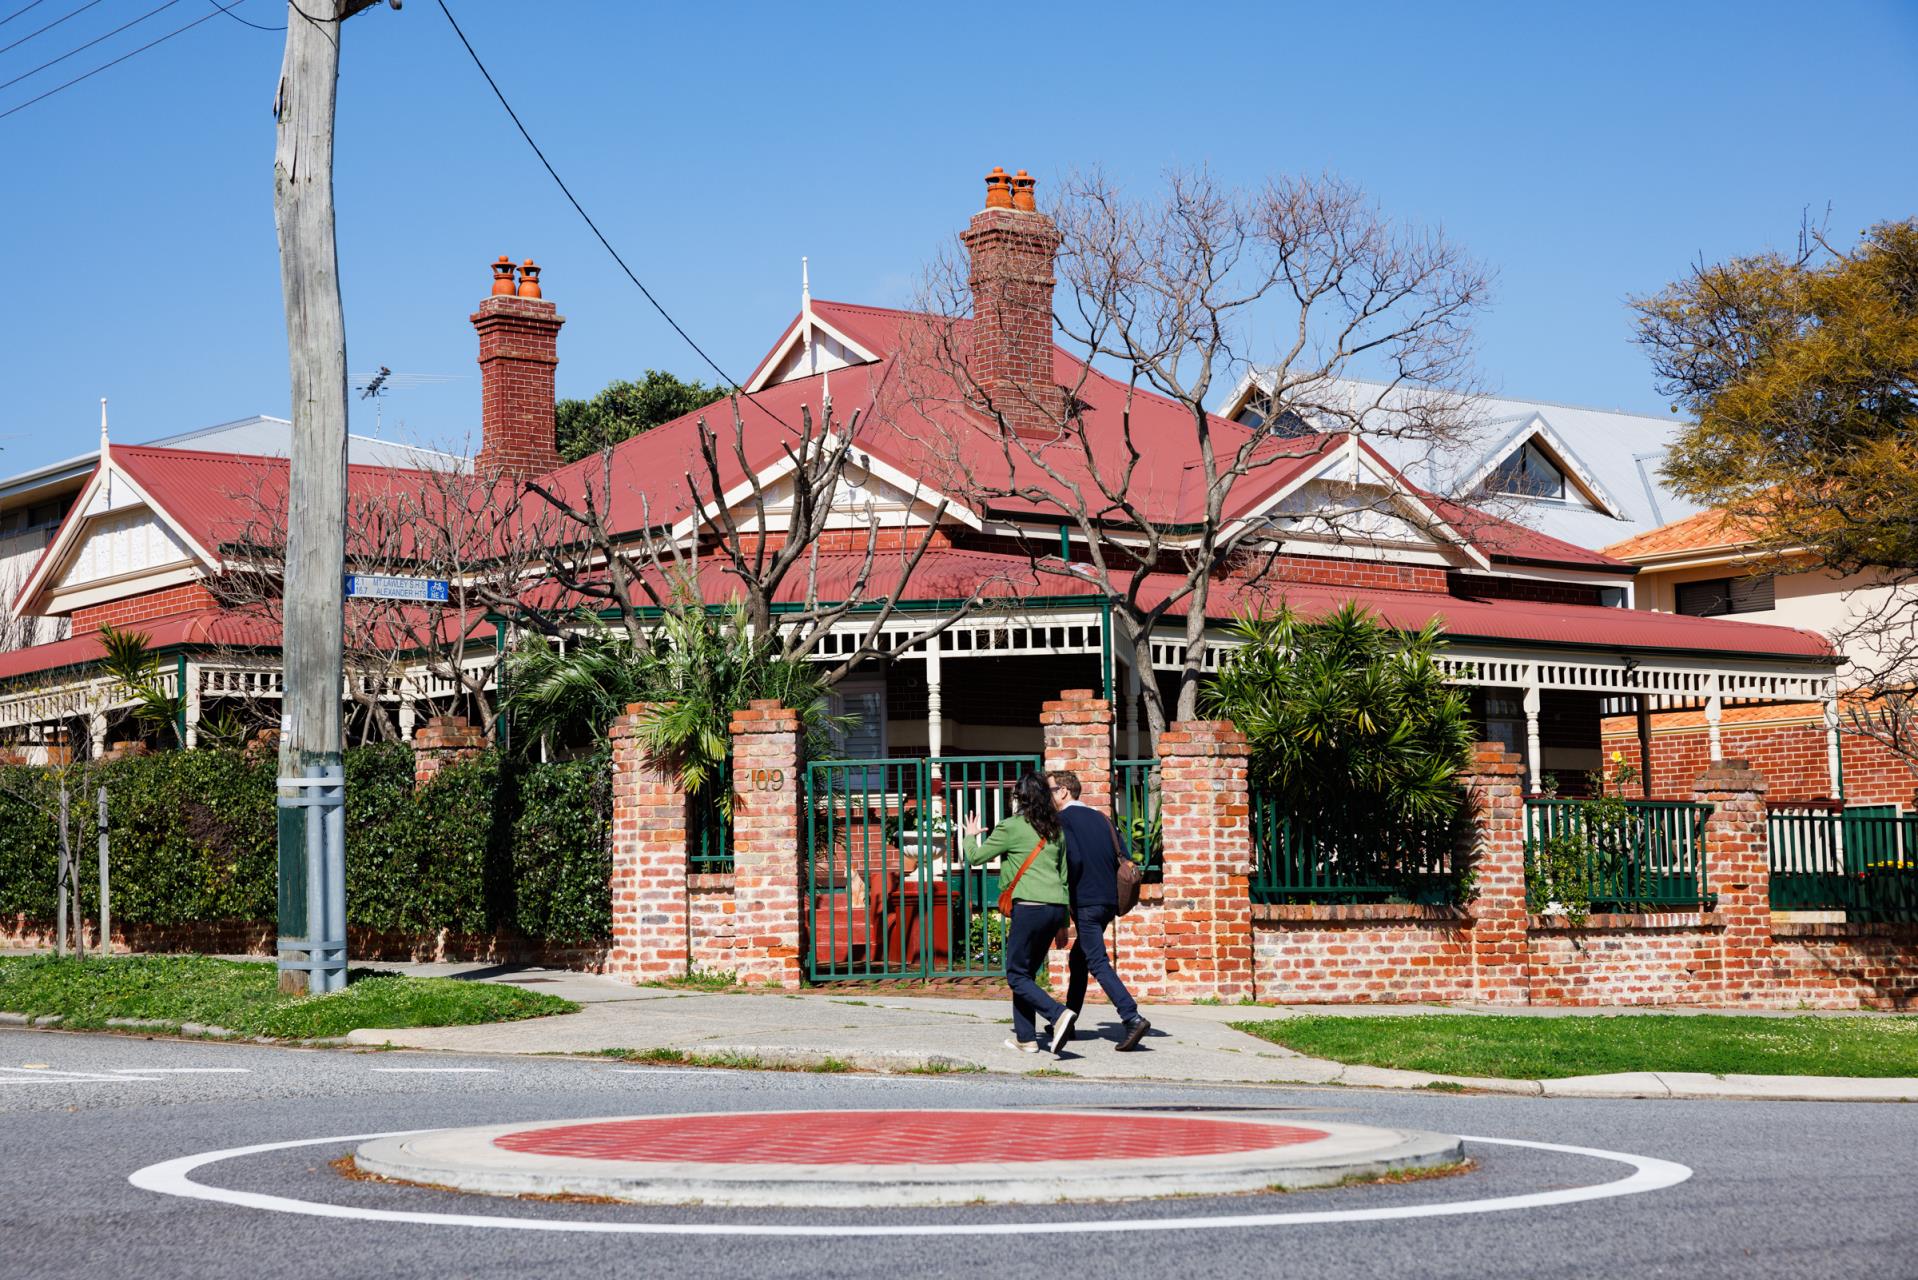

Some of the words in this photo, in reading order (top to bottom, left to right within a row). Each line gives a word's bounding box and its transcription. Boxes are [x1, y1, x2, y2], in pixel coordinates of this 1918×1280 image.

[384, 578, 409, 587] LAWLEY
[376, 587, 412, 596] ALEXANDER
[415, 590, 426, 598] HTS
[744, 768, 784, 791] 109
